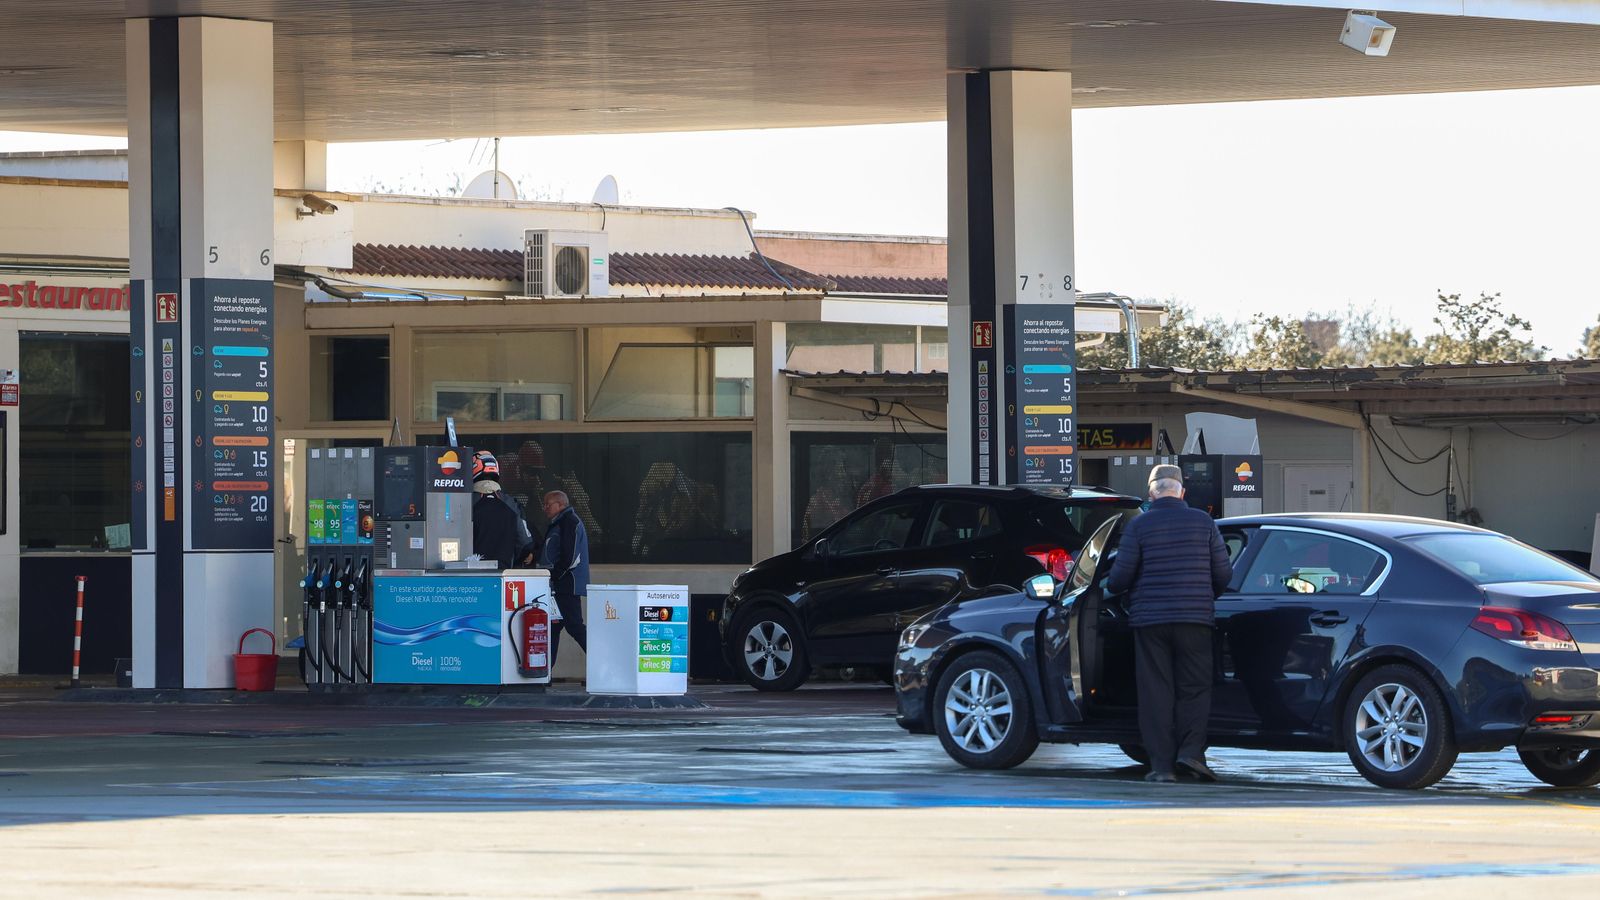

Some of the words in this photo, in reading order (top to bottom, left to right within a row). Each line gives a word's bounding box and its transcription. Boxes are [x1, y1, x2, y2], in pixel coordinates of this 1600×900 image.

[209, 246, 218, 264] 5
[260, 249, 270, 266] 6
[1020, 276, 1028, 290] 7
[1064, 275, 1072, 290] 8
[245, 306, 268, 314] energías
[259, 362, 268, 378] 5
[1064, 378, 1070, 392] 5
[252, 406, 268, 422] 10
[1058, 418, 1072, 434] 10
[1158, 433, 1164, 450] 8
[252, 451, 268, 468] 15
[1060, 458, 1072, 474] 15
[434, 479, 464, 488] REPSOL
[250, 496, 268, 512] 20
[409, 504, 415, 514] 5
[314, 520, 324, 528] 98
[330, 520, 340, 528] 95
[436, 586, 457, 594] puedes
[458, 586, 483, 594] repostar
[662, 643, 671, 652] 95
[412, 656, 432, 666] Diesel
[440, 657, 462, 666] 100%
[662, 661, 671, 670] 98
